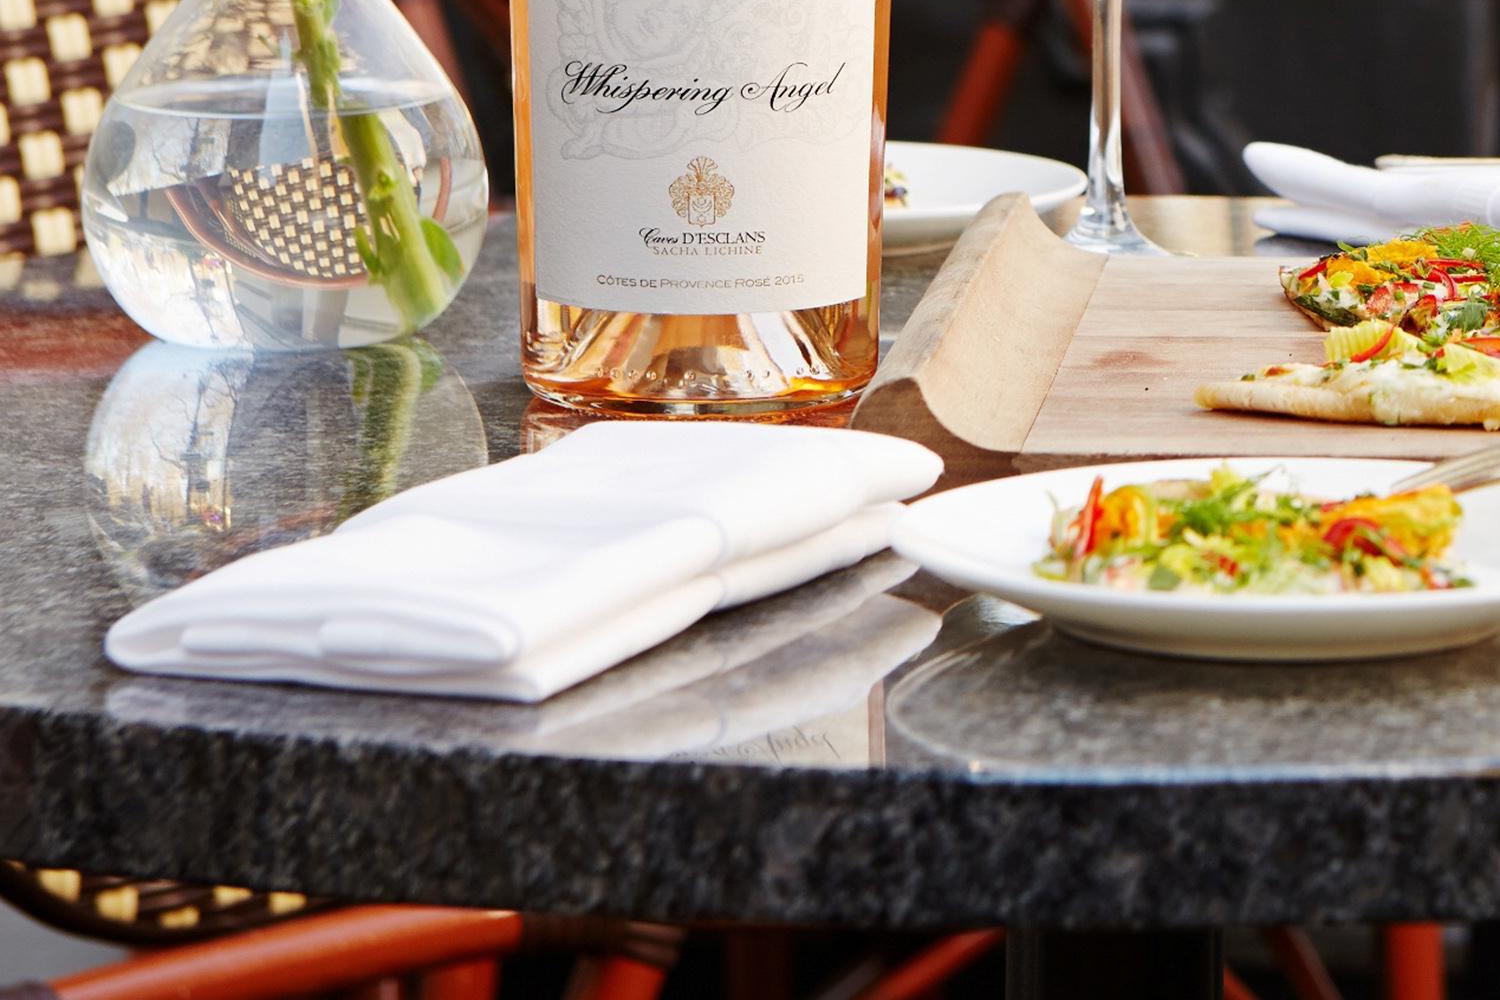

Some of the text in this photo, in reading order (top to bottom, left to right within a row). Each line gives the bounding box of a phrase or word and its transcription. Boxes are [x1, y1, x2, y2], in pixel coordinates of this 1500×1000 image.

[560, 60, 846, 116] Whispering Angel
[639, 227, 766, 248] Caves D'ESCLANS
[653, 245, 763, 256] SACHA LICHINE
[596, 274, 637, 287] CÔTES
[640, 279, 657, 288] DE
[735, 276, 771, 288] ROSÉ
[774, 274, 805, 286] 2015
